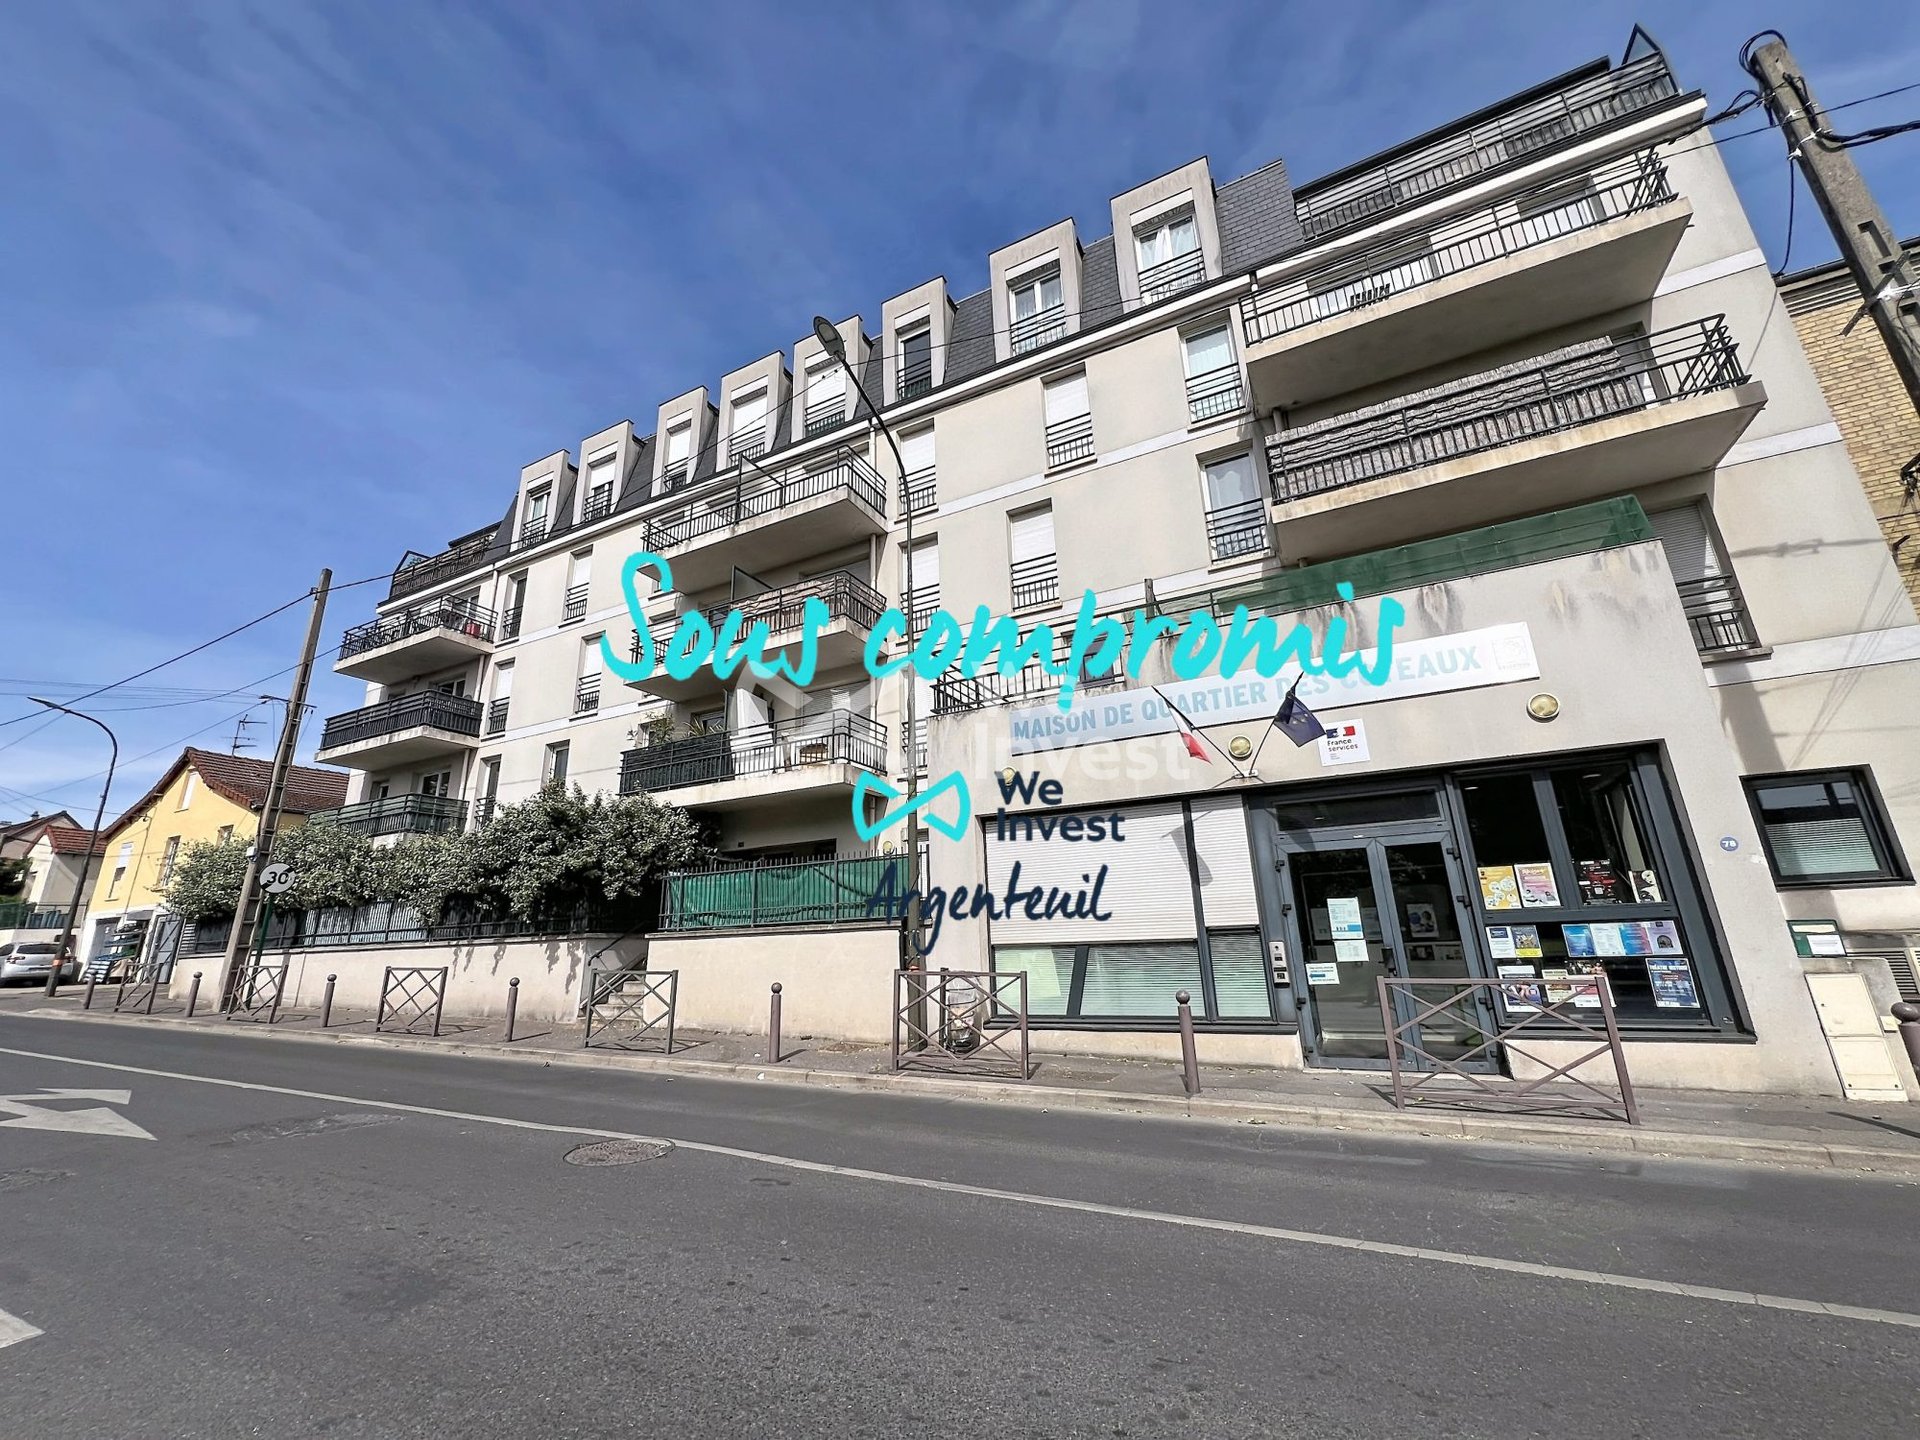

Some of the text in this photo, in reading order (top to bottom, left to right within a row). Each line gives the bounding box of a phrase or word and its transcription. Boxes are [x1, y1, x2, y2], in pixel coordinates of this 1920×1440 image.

[1014, 646, 1482, 742] MAISON DE QUARTIER DES CEAUX
[1327, 738, 1353, 747] France
[1328, 743, 1358, 752] services
[266, 871, 289, 885] 30
